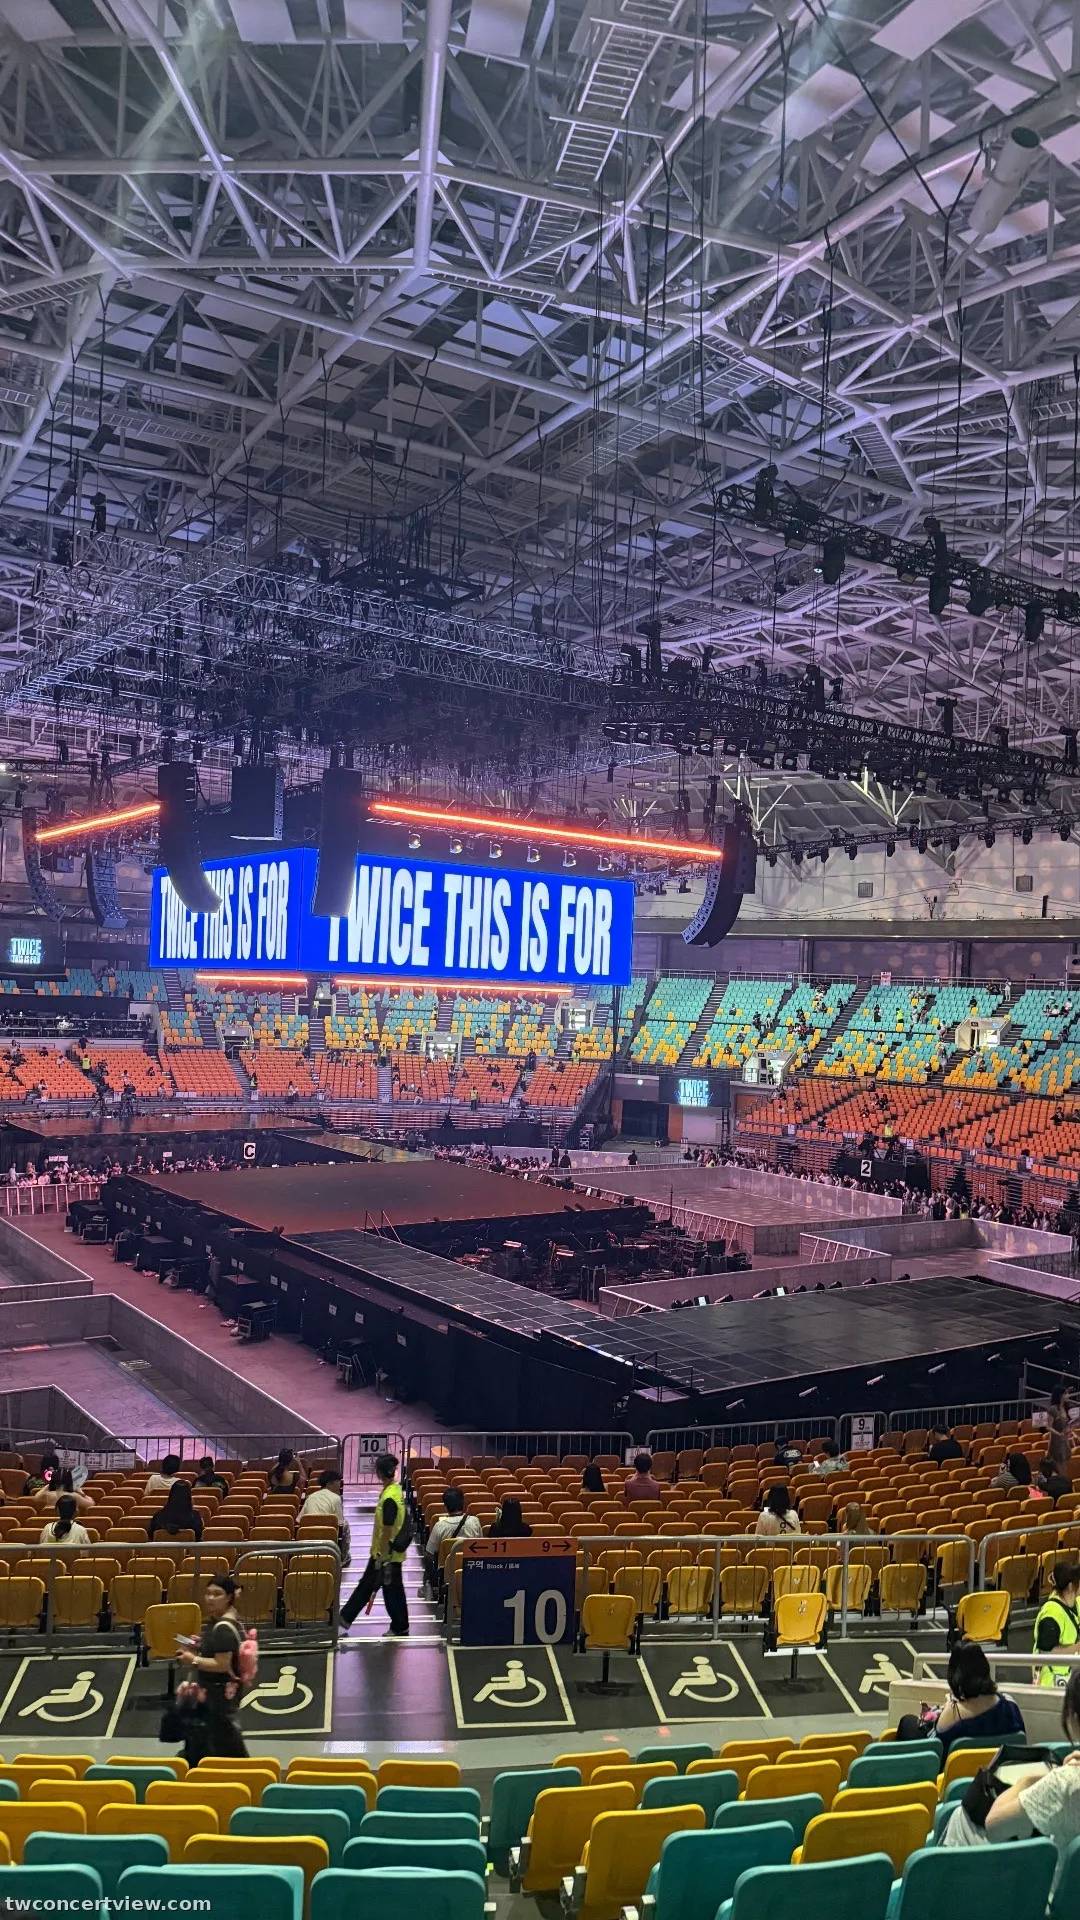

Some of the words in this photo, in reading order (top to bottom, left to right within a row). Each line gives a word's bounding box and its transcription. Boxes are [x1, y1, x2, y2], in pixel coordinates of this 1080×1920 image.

[237, 865, 253, 960] IS
[257, 861, 290, 960] FOR
[444, 873, 512, 970] THIS
[520, 881, 549, 973] IS
[558, 885, 613, 976] FOR
[11, 938, 42, 956] TWICE
[679, 1079, 709, 1098] TWICE
[245, 1144, 255, 1157] C
[862, 1161, 871, 1174] 2
[858, 1418, 866, 1431] 9
[362, 1439, 380, 1453] 10
[492, 1541, 508, 1553] 11
[542, 1541, 551, 1552] 9
[467, 1560, 484, 1570] 구역
[504, 1589, 567, 1645] 10
